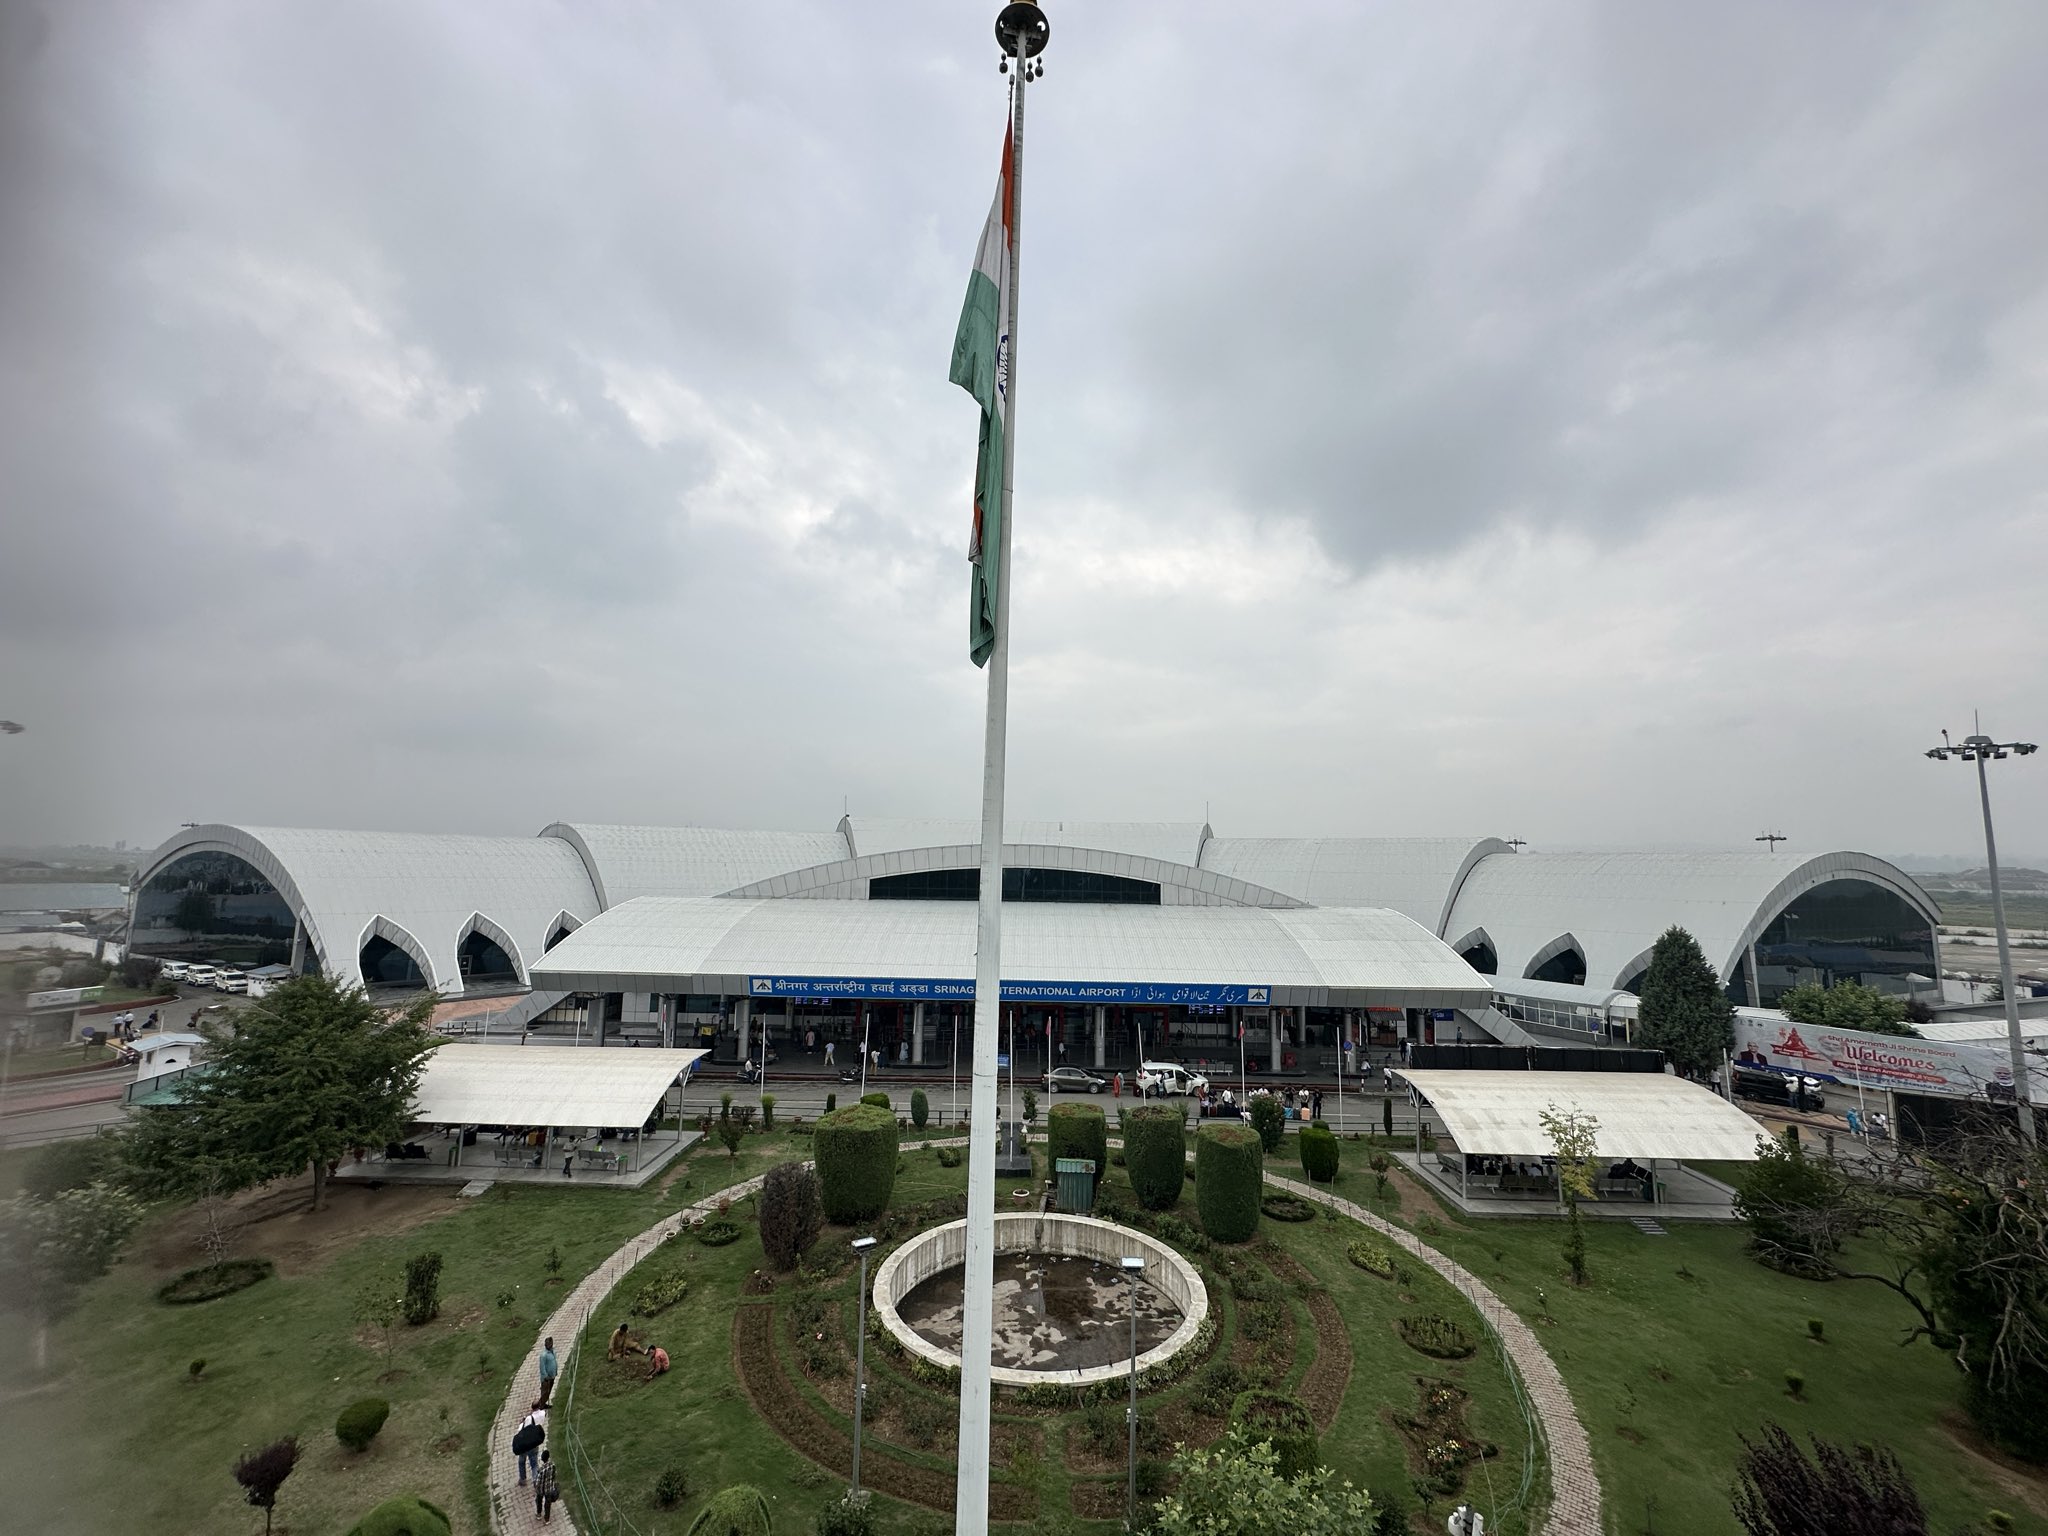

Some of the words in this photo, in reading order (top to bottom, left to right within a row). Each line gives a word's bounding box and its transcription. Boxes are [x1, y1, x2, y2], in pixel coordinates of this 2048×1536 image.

[775, 979, 808, 991] श्रीनगर
[870, 982, 894, 993] हवाई
[934, 985, 976, 994] SRINAG
[999, 986, 1076, 996] TERNATIONAL
[1079, 987, 1126, 997] AIRPORT
[82, 990, 102, 999] ATM
[1845, 1045, 1936, 1070] Welcomes
[1927, 1048, 1956, 1058] Board
